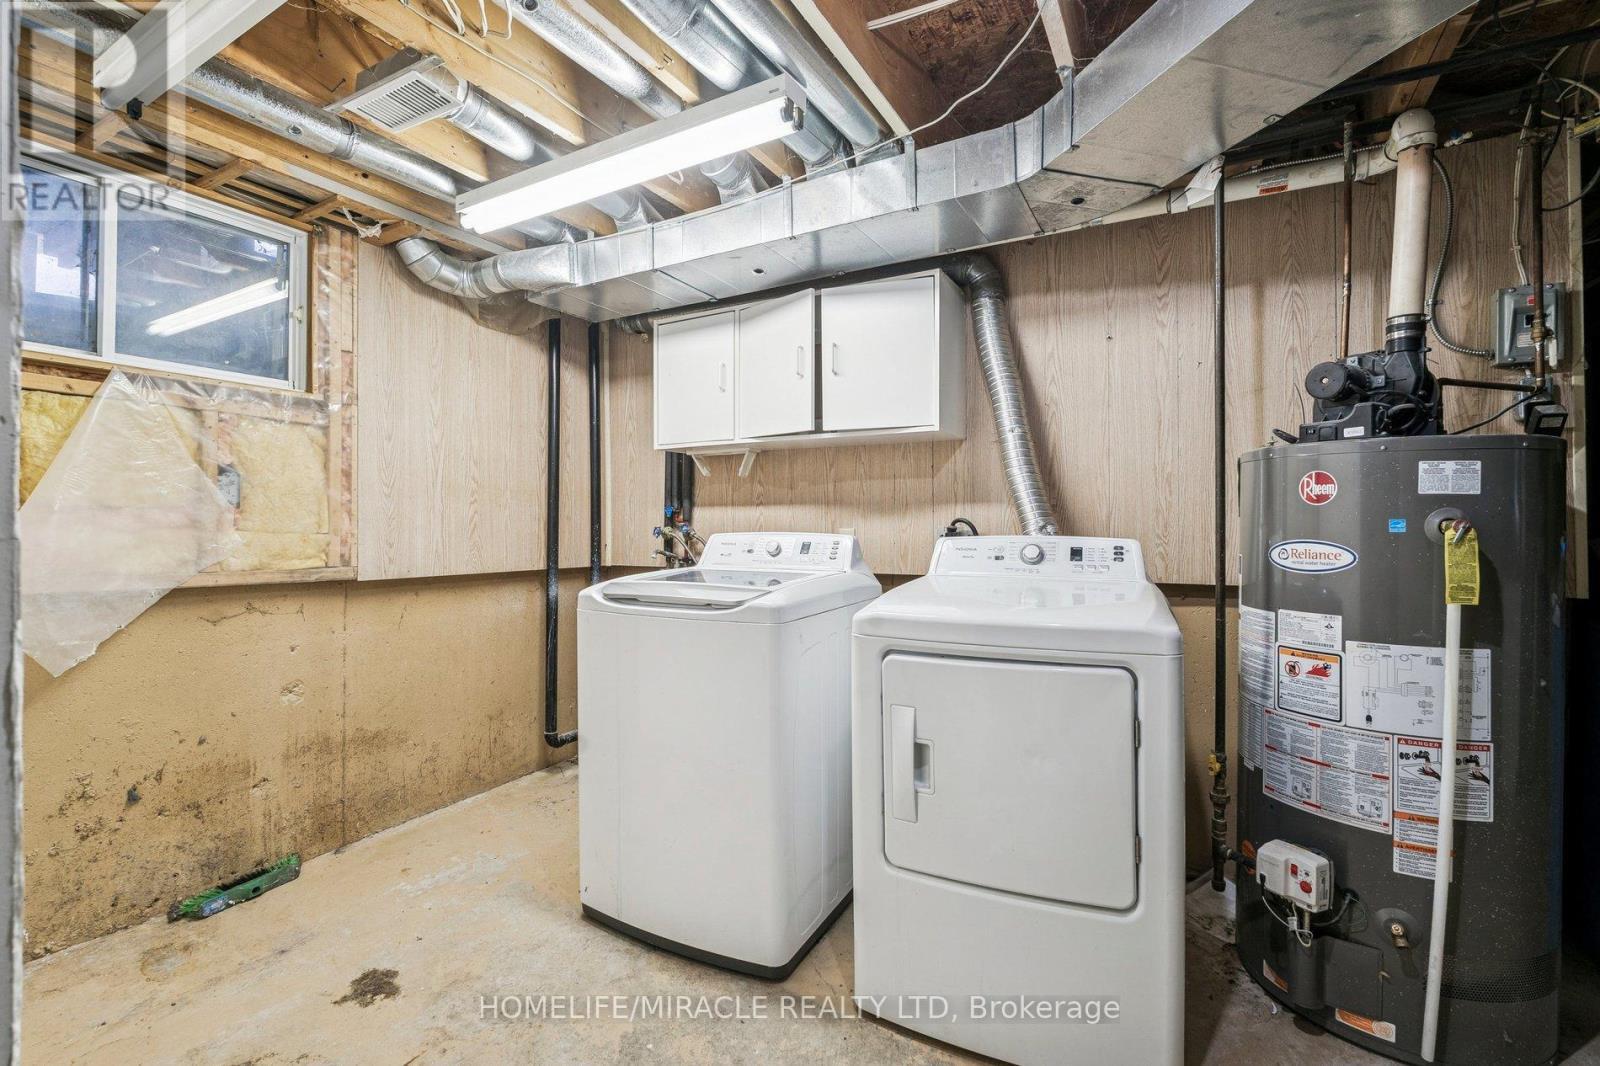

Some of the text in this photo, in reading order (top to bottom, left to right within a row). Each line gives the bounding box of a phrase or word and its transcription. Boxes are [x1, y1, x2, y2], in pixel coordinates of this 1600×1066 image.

[1304, 472, 1335, 499] Rheem
[1291, 548, 1342, 561] Reliance
[1407, 740, 1440, 748] DANGER
[1458, 743, 1489, 751] DANGER
